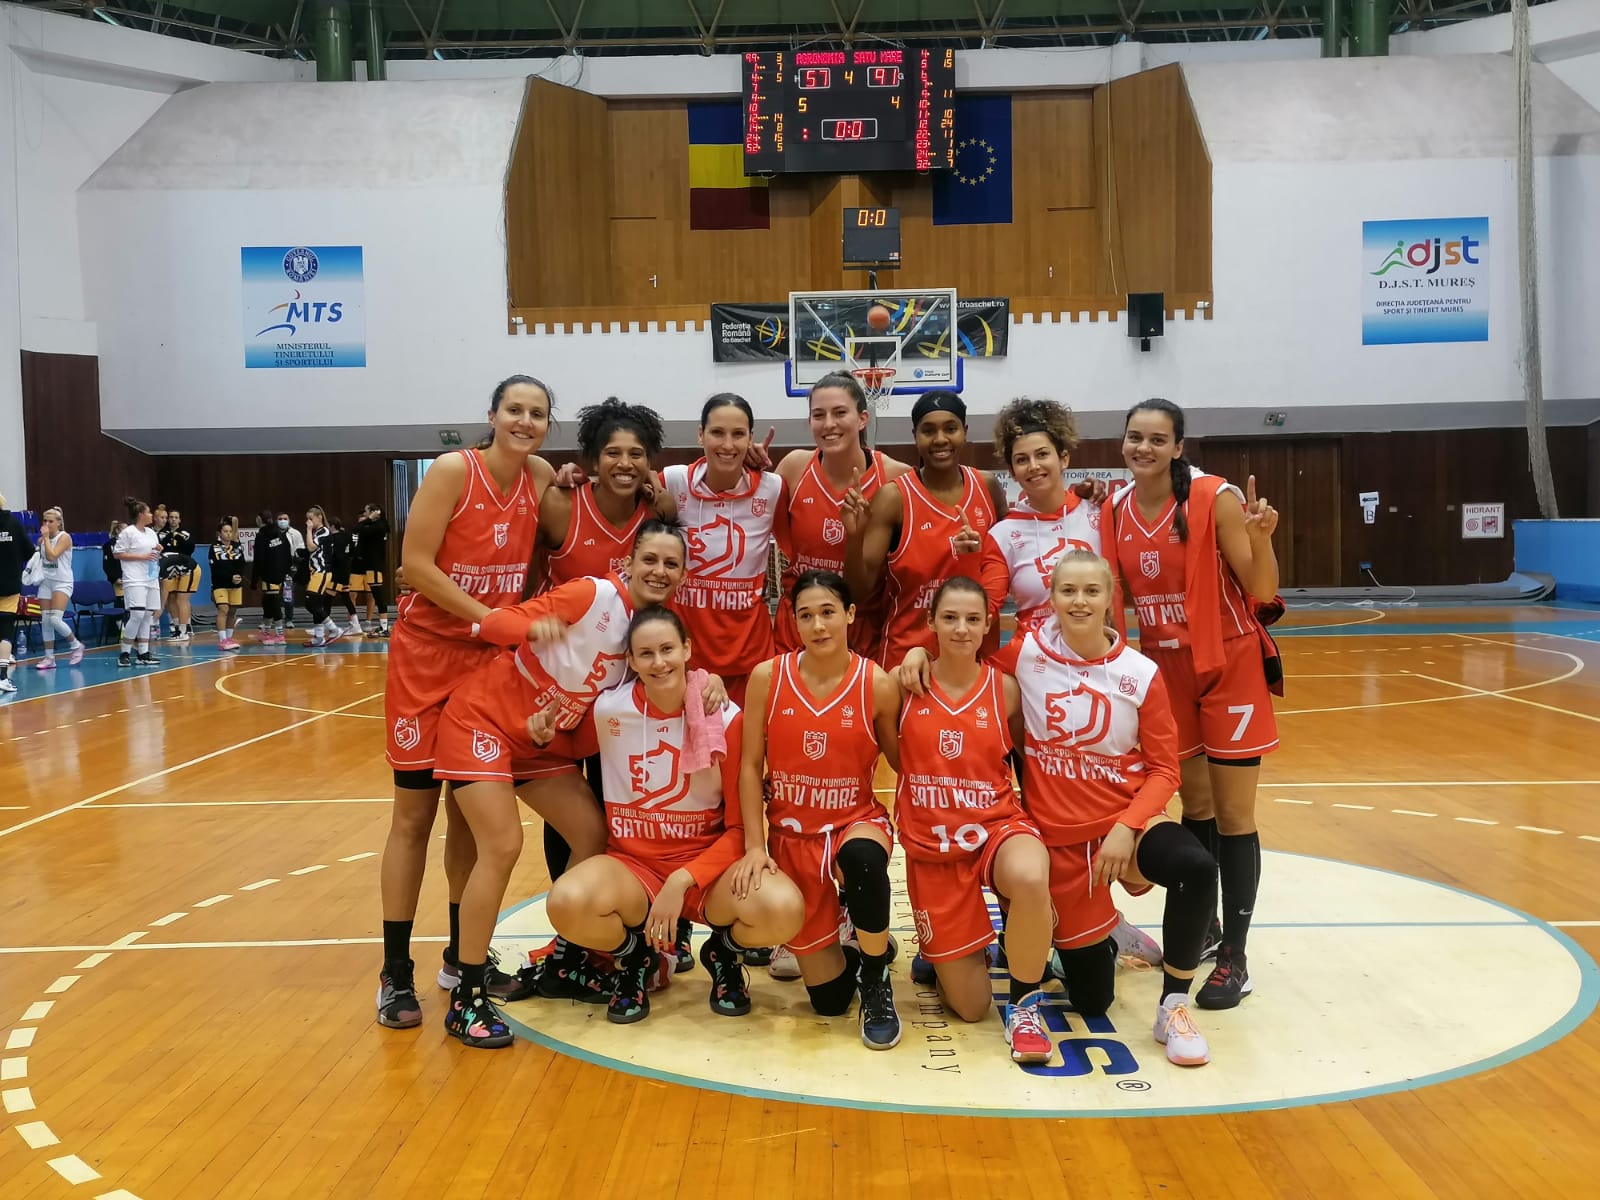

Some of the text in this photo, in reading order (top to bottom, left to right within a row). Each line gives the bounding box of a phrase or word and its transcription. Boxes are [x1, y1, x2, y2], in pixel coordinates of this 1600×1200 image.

[745, 53, 757, 63] 99
[776, 52, 783, 62] 3
[853, 50, 903, 64] SATU MARE
[776, 62, 783, 72] 7
[921, 59, 928, 69] 5
[943, 58, 952, 68] 15
[751, 73, 758, 82] 4
[776, 72, 783, 82] 5
[806, 70, 829, 87] 57
[844, 70, 854, 85] 4
[875, 68, 898, 85] 91
[752, 83, 758, 92] 7
[943, 89, 952, 98] 11
[749, 103, 758, 112] 10
[798, 97, 807, 113] 5
[891, 96, 900, 110] 4
[749, 113, 758, 122] 12
[774, 112, 783, 122] 14
[918, 109, 928, 119] 11
[943, 109, 953, 118] 10
[919, 119, 928, 129] 12
[940, 118, 953, 128] 24
[836, 121, 862, 138] 0:0
[916, 129, 928, 139] 22
[944, 129, 953, 139] 11
[774, 132, 783, 142] 15
[776, 142, 783, 152] 5
[946, 148, 953, 158] 3
[947, 158, 953, 168] 7
[857, 209, 886, 226] 0:0
[1407, 235, 1479, 275] djst
[1379, 279, 1424, 289] D.J.S.T.
[286, 302, 343, 323] MTS
[274, 351, 334, 359] TINERETULUI
[1466, 506, 1501, 515] HIDRANT
[1366, 510, 1374, 522] B
[674, 585, 707, 609] SATU
[1159, 603, 1188, 625] MA
[534, 691, 579, 729] STU
[1227, 703, 1254, 742] 7
[1037, 750, 1077, 779] SATU
[790, 774, 821, 787] SPORTIV
[821, 777, 860, 788] MUNICIPAL
[773, 780, 860, 810] ATU MARE
[910, 785, 950, 809] SATU
[612, 806, 638, 818] CLUBUL
[666, 813, 706, 823] MUNICIPAL
[611, 816, 706, 840] SATU MARE
[931, 823, 989, 853] 10
[912, 990, 962, 1075] ompany
